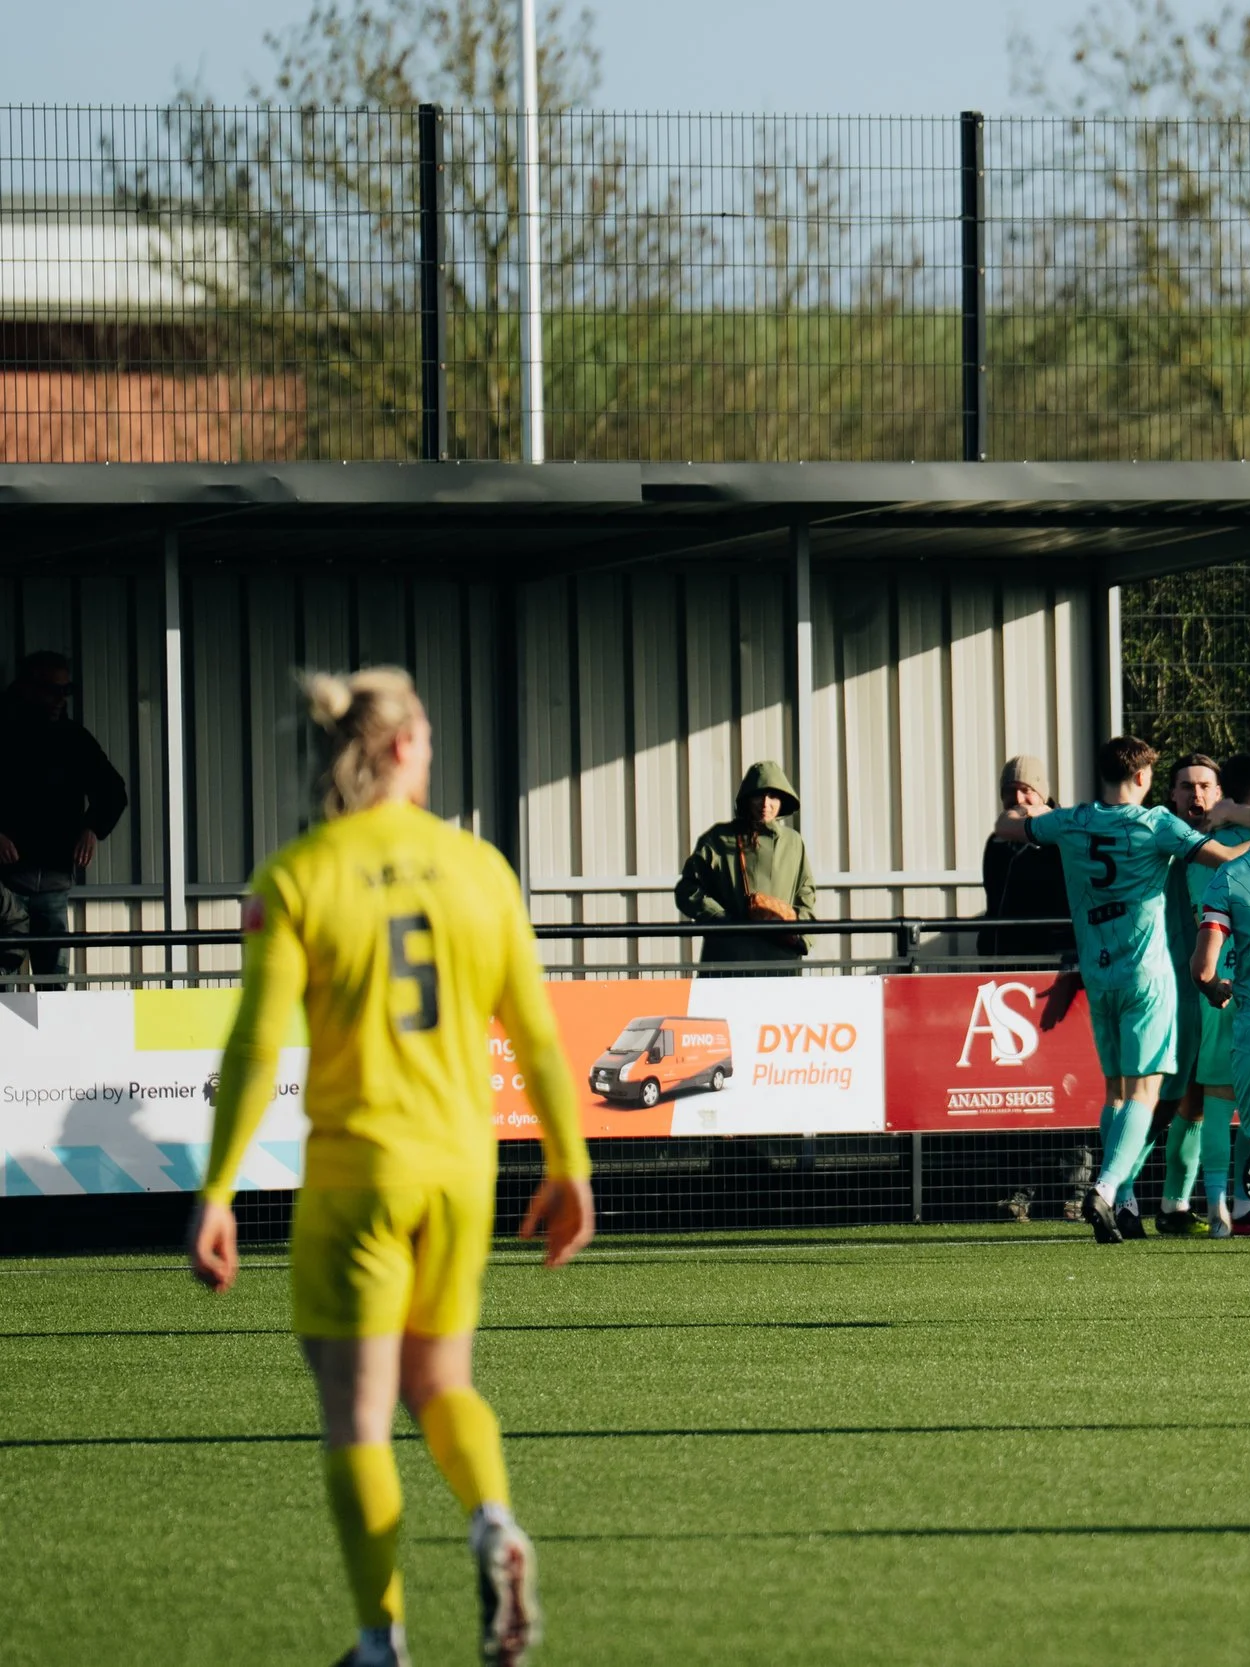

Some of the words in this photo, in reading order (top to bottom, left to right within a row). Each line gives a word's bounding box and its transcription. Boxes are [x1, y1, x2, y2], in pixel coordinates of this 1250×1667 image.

[1089, 835, 1118, 889] 5
[388, 911, 440, 1034] 5
[755, 1023, 857, 1054] DYNO
[955, 979, 1040, 1069] AS
[681, 1033, 714, 1048] DYNO
[751, 1060, 853, 1091] Plumbing
[3, 1082, 98, 1108] Supported
[102, 1081, 125, 1106] by
[128, 1079, 197, 1100] Premier
[947, 1093, 1005, 1109] ANAND
[1005, 1091, 1055, 1107] SHOES
